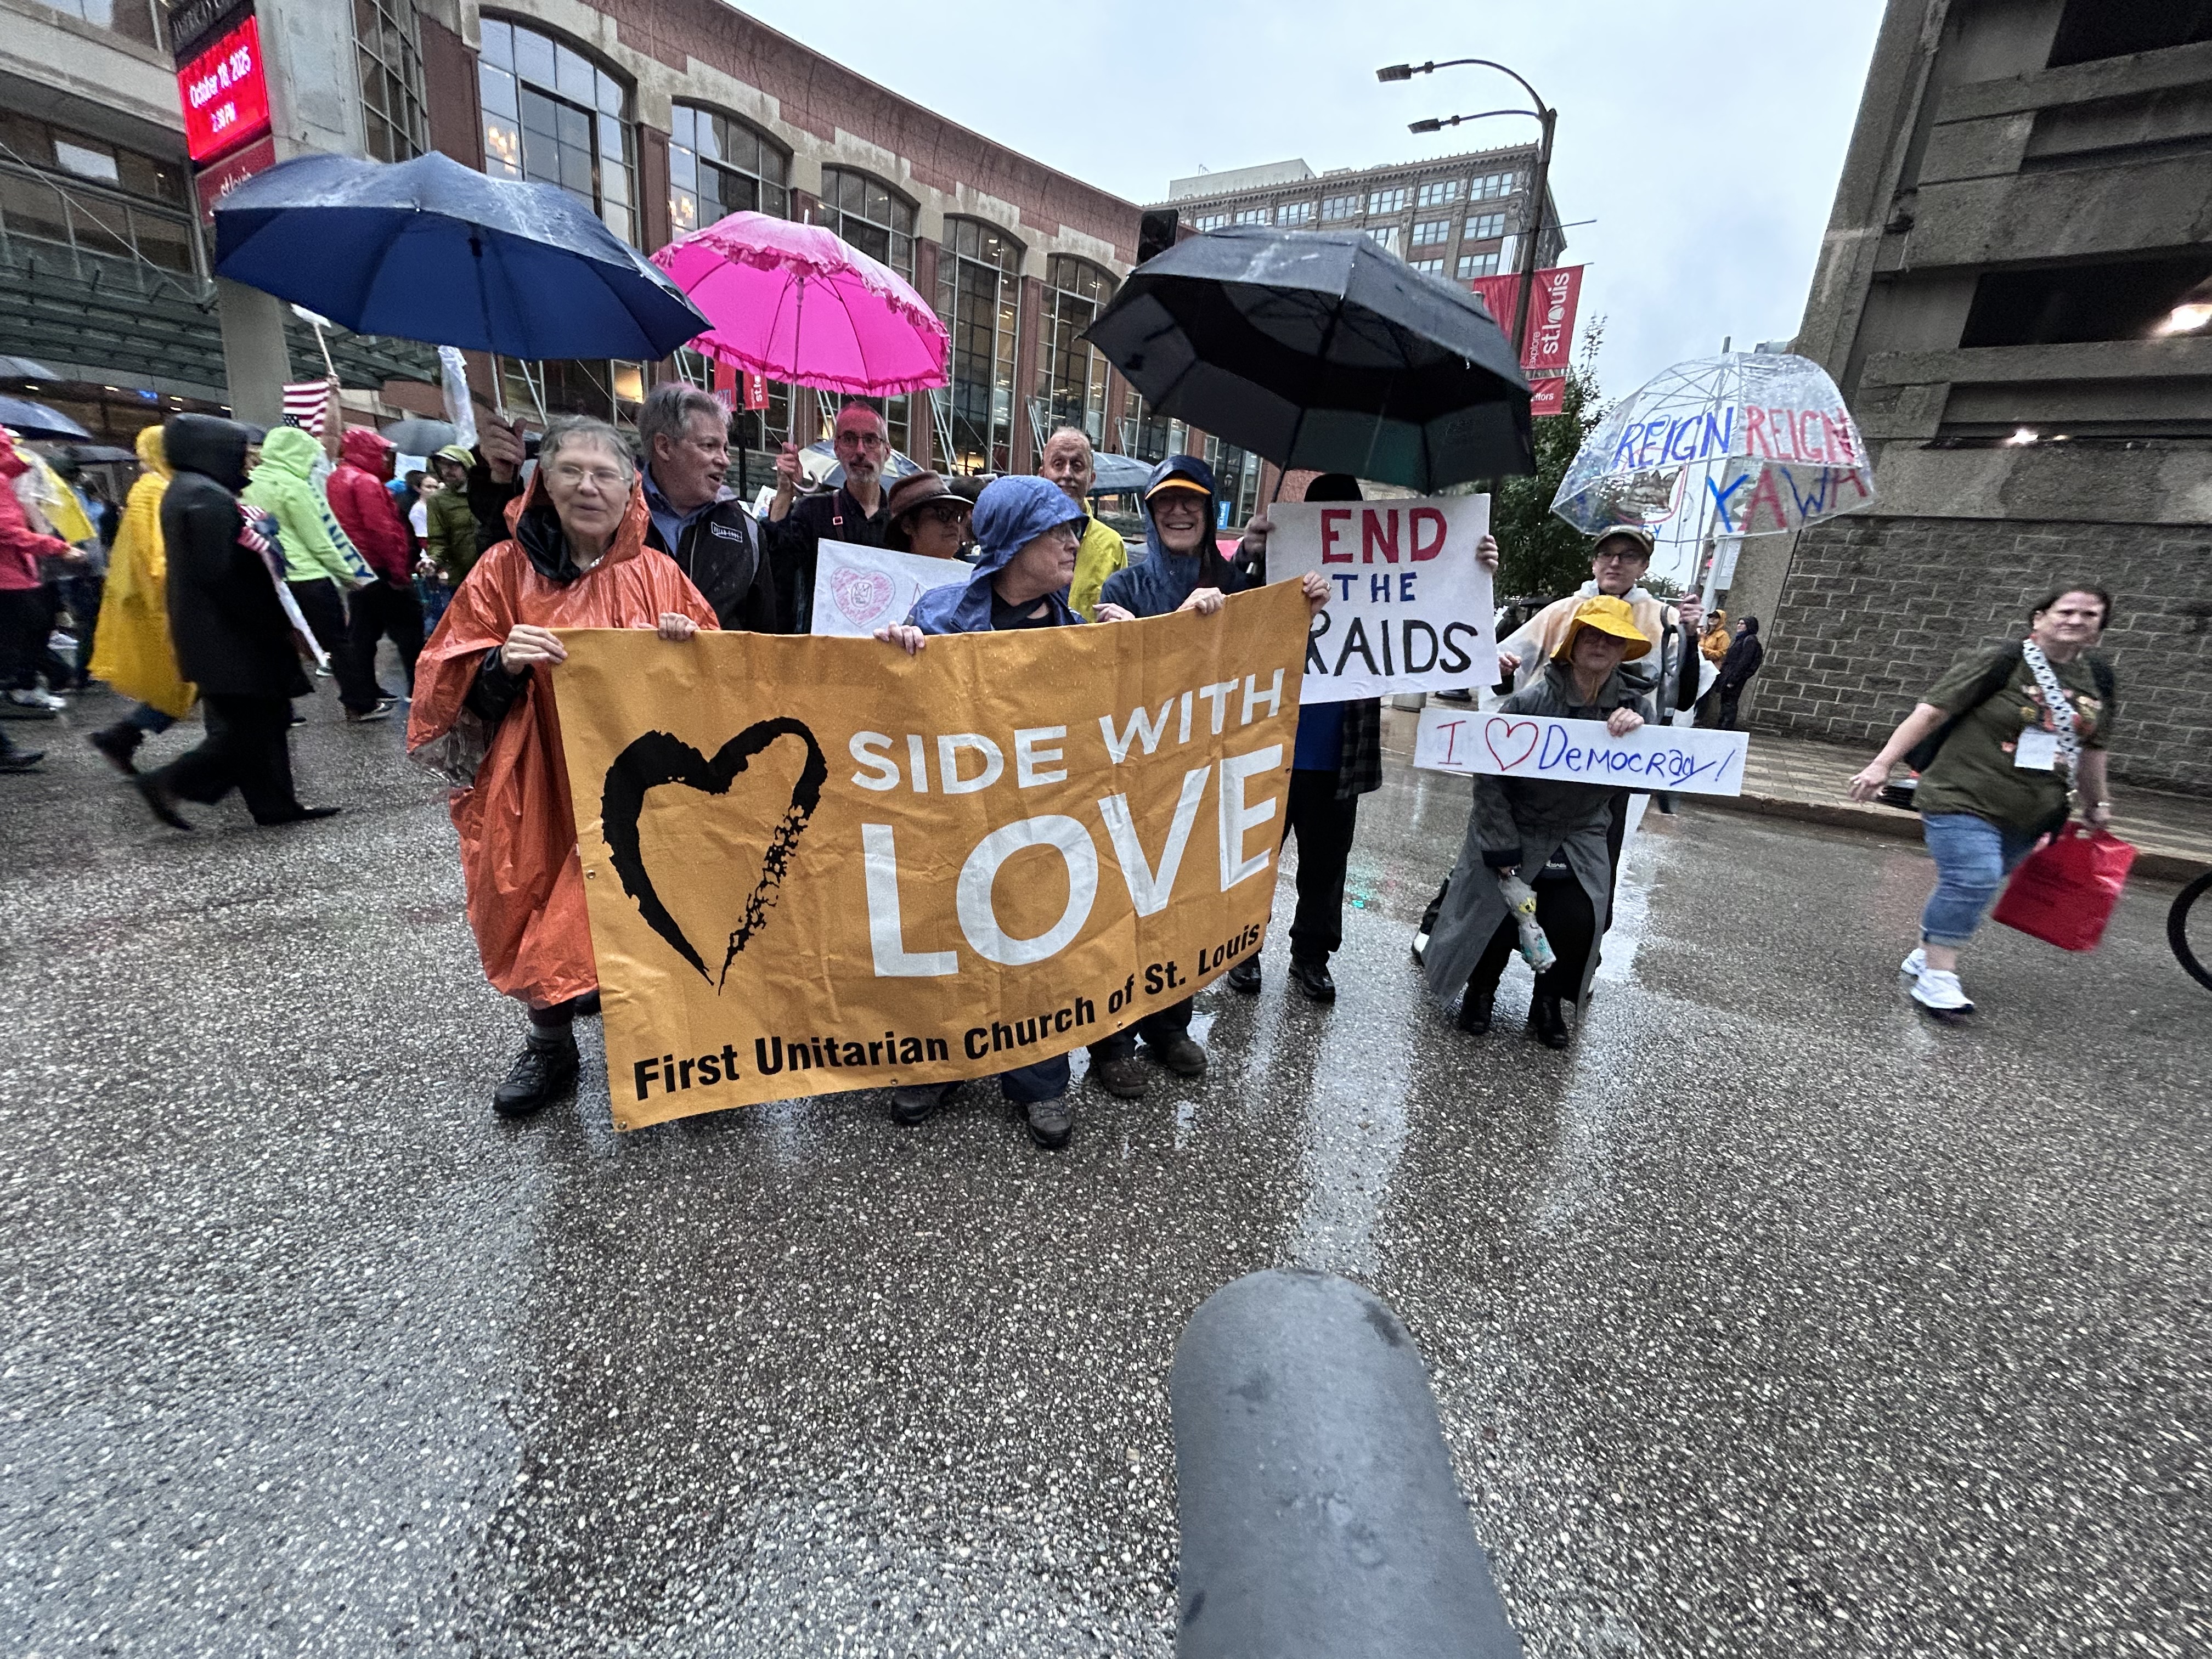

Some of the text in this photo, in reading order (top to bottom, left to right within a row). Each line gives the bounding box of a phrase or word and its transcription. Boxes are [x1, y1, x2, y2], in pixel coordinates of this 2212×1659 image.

[189, 75, 218, 108] October
[230, 45, 252, 81] 2025
[1612, 405, 1857, 468] REIGN REIGN
[1321, 507, 1447, 564] END
[1332, 572, 1417, 603] THE
[1304, 610, 1478, 676] RAIDS
[849, 668, 1285, 794] SIDE WITH
[1437, 720, 1466, 765] I
[862, 744, 1283, 977] LOVE
[634, 923, 1260, 1101] First Unitarian Church of St. Louis
